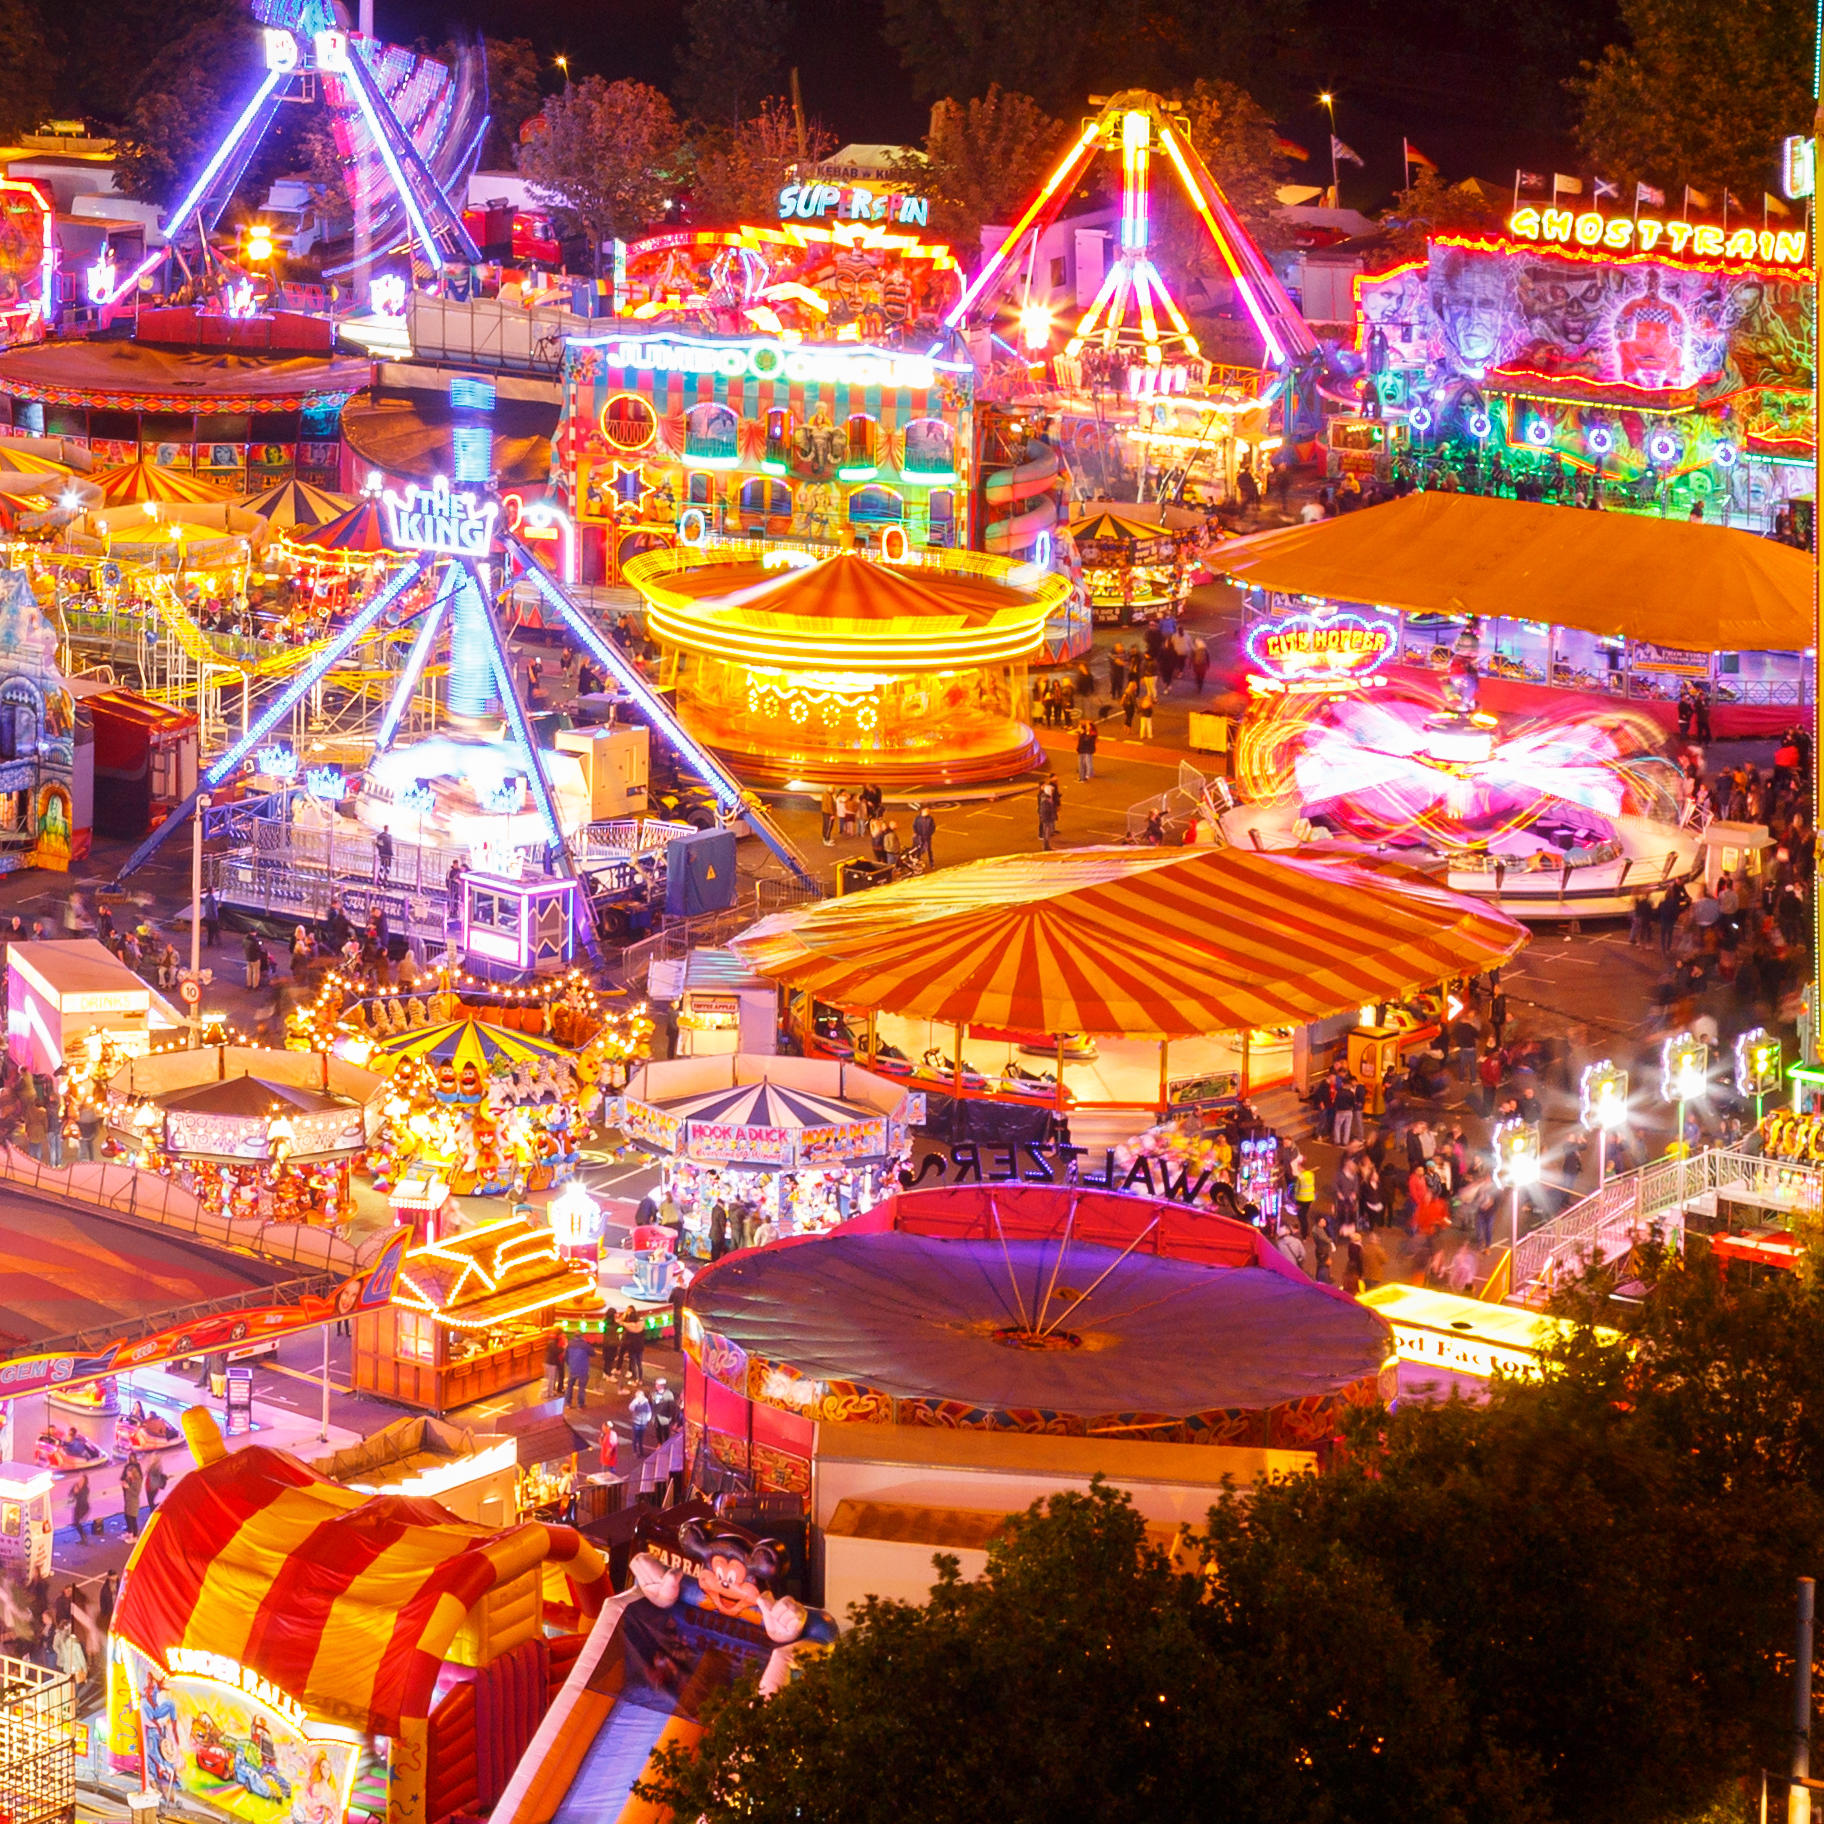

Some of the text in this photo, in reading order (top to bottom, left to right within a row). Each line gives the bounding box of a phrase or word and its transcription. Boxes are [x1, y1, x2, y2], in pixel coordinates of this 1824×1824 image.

[817, 167, 858, 178] KEBAB
[778, 184, 930, 226] SUPER SPIN
[606, 341, 748, 378] JUMBO
[399, 488, 486, 549] THE KING
[1267, 629, 1386, 655] CITY HOPPER
[80, 995, 132, 1009] DRINKS
[184, 985, 199, 998] 10
[692, 1124, 789, 1142] HOOK A DUCK
[801, 1120, 884, 1142] HOOK A DUCK
[1438, 1339, 1548, 1378] Factor
[648, 1540, 705, 1578] FARRA
[166, 1647, 308, 1730] KINDER RALLY
